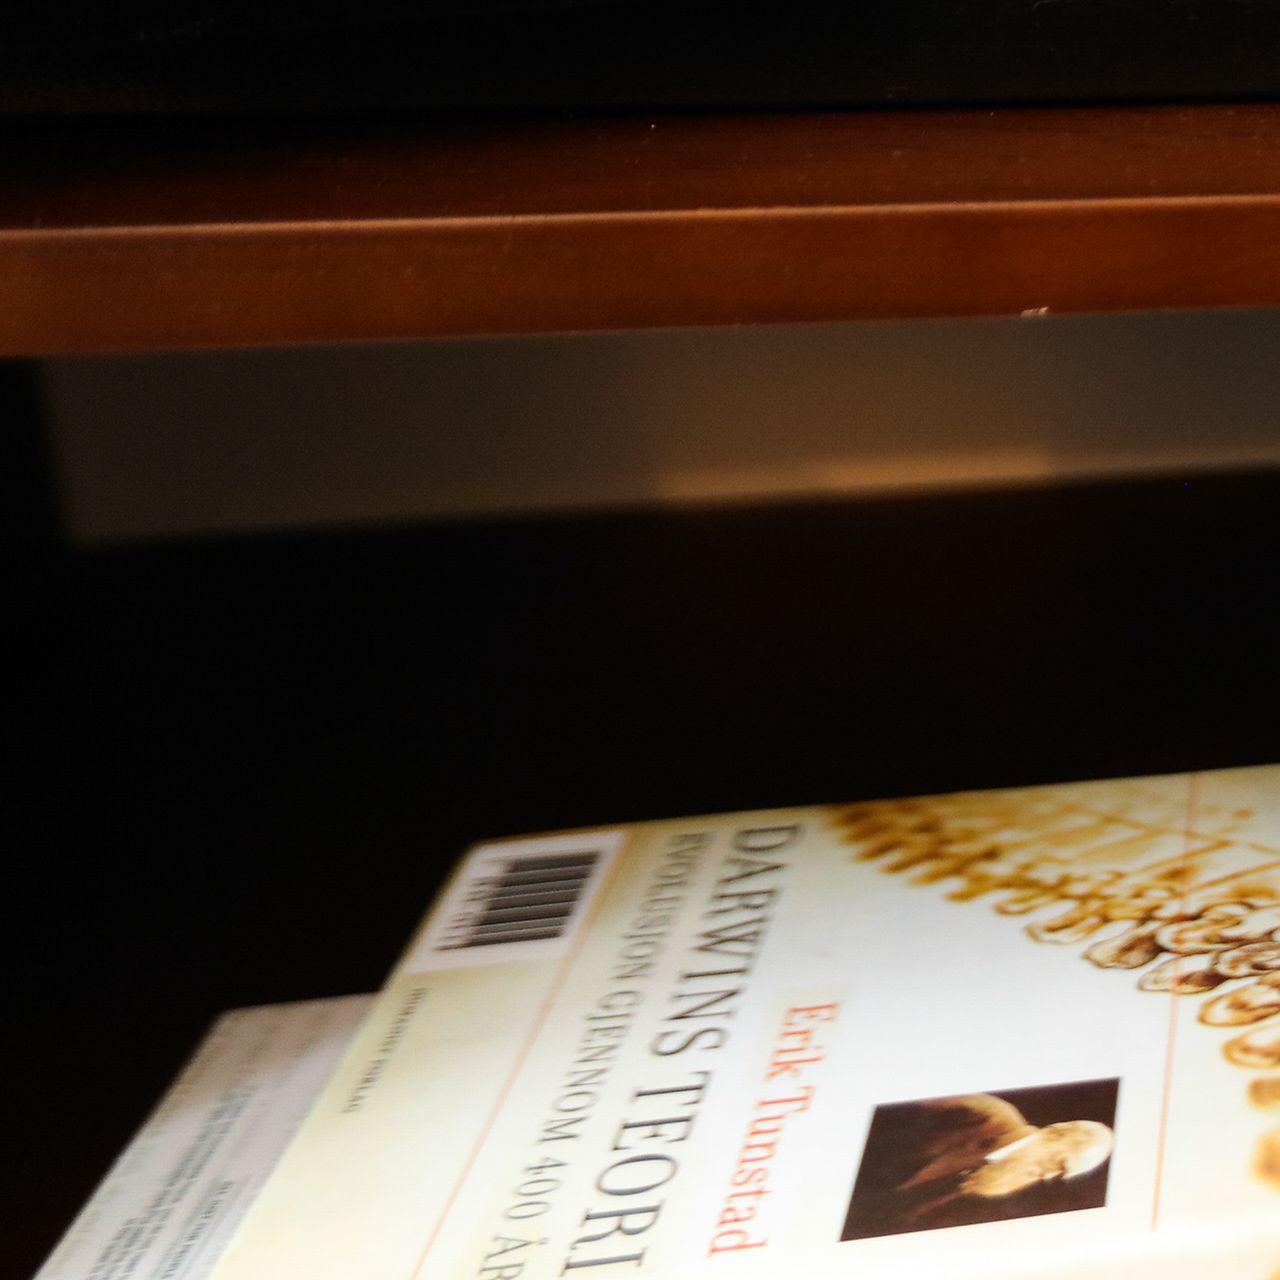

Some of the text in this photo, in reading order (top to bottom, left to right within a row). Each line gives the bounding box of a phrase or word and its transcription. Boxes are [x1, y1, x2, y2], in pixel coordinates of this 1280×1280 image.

[535, 990, 643, 1144] GJENNOM
[559, 824, 803, 1278] DARWINS TEORI
[706, 1002, 840, 1258] Erik Tunstad
[505, 1156, 570, 1220] 400
